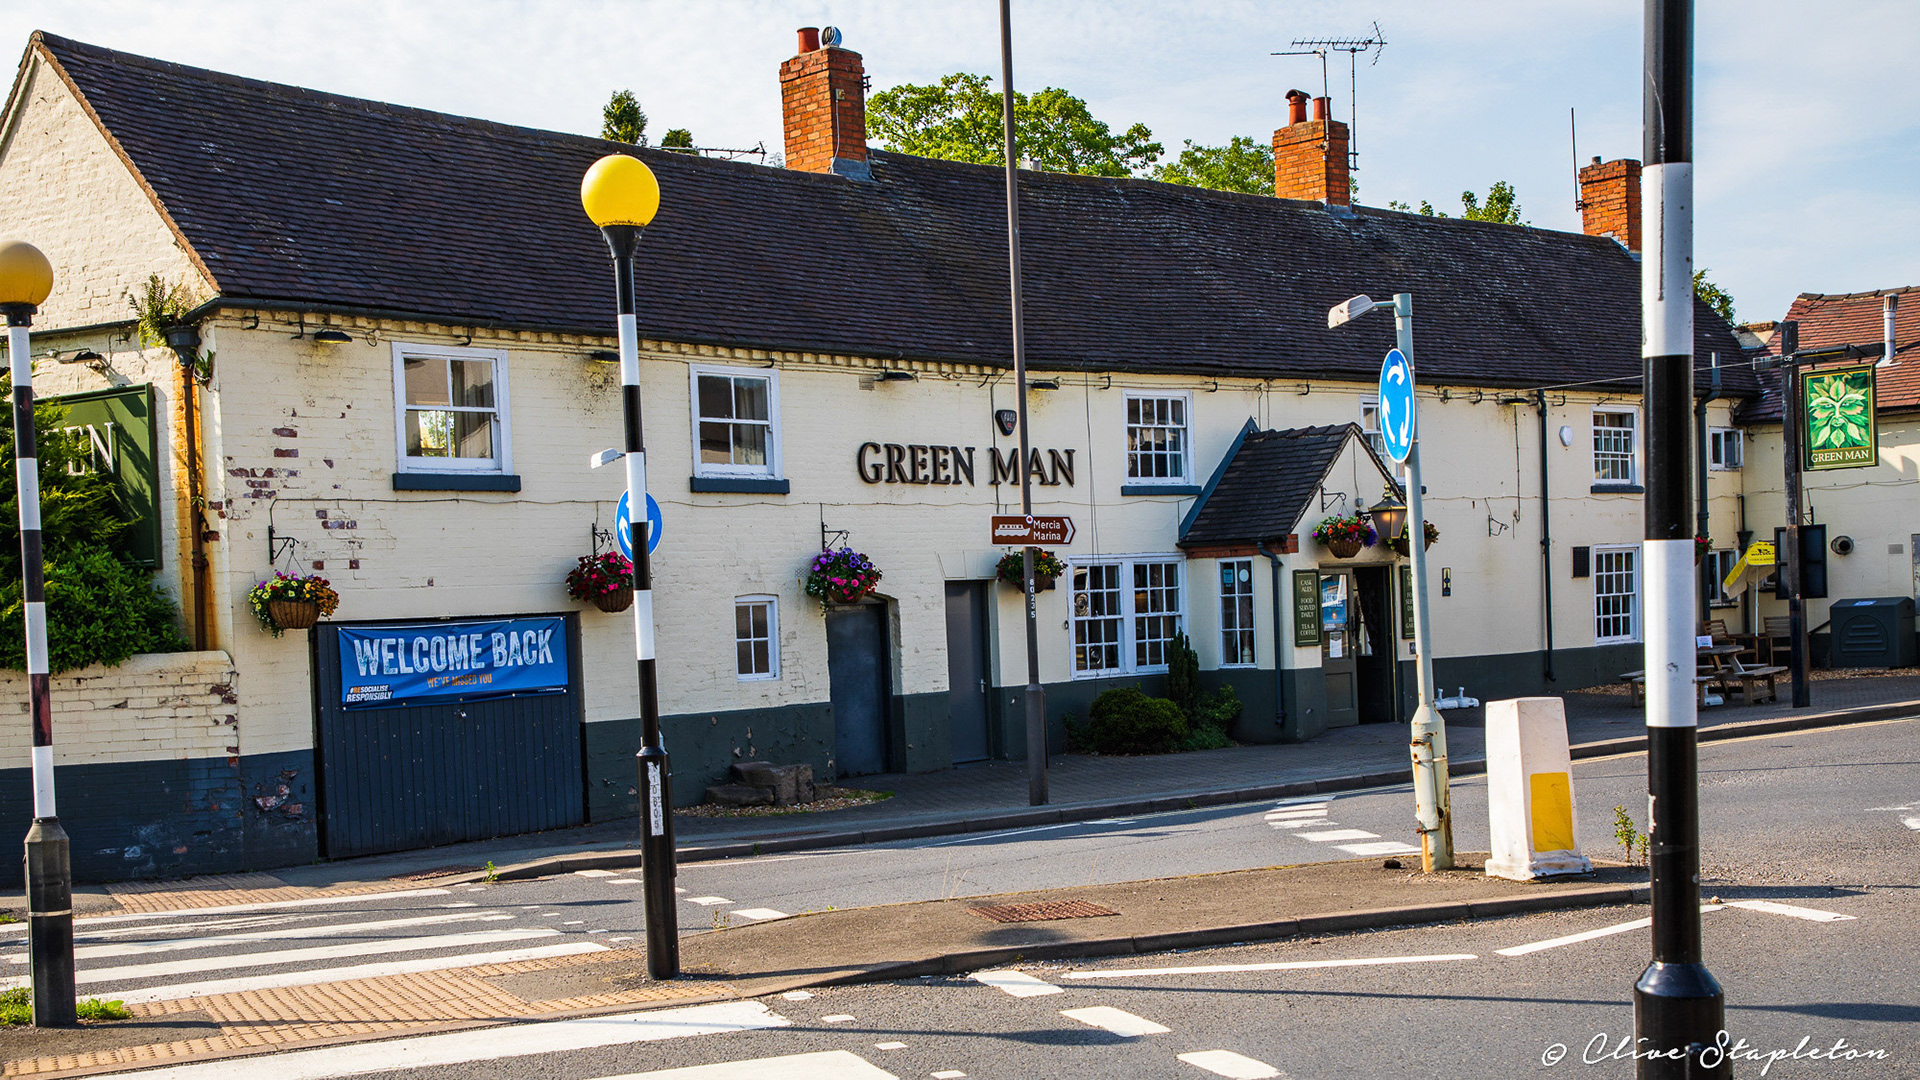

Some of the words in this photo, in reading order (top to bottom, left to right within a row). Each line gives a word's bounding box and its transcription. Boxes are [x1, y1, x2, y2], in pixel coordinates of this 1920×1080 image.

[1811, 451, 1843, 463] GREEN
[1845, 449, 1869, 460] MAN
[858, 442, 975, 487] GREEN
[989, 447, 1075, 487] MAN
[1033, 520, 1061, 529] Mercia
[1033, 531, 1061, 540] Marina
[353, 633, 485, 677] WELCOME
[491, 629, 554, 668] BACK
[426, 676, 450, 689] WE'VE
[451, 674, 477, 687] MISSED
[479, 673, 492, 684] YOU
[346, 691, 393, 702] RESPONSIBLY
